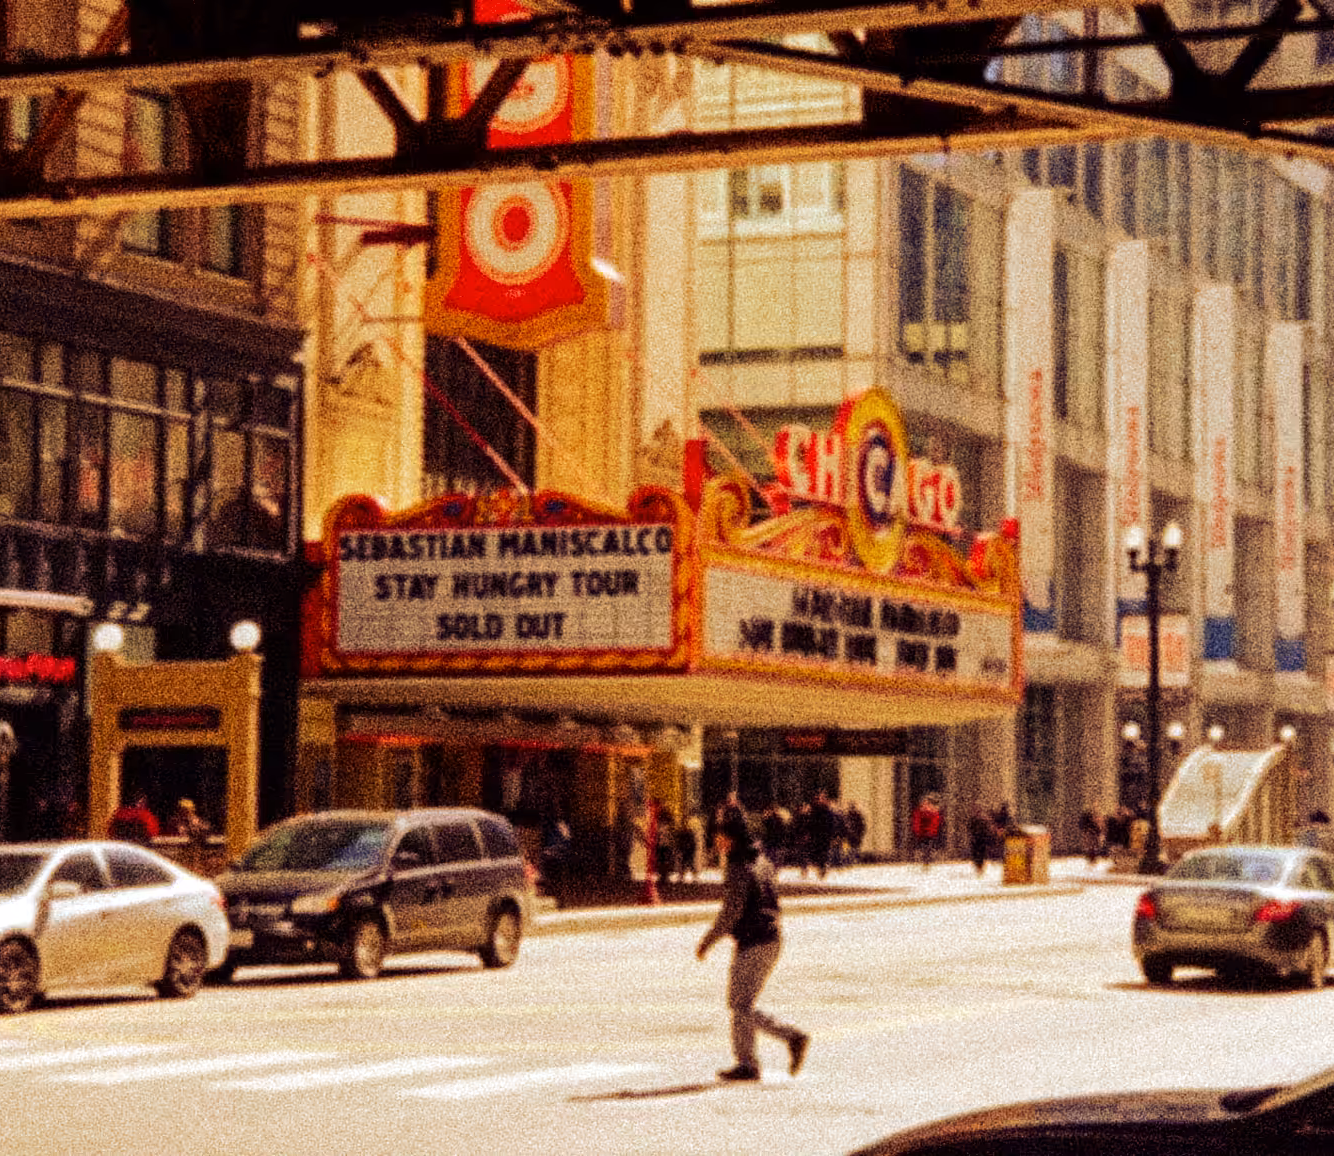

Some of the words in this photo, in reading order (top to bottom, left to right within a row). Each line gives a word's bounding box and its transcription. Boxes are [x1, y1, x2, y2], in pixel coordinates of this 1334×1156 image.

[340, 533, 486, 562] SEBASTIAN
[498, 527, 672, 558] MANISCALCO
[374, 573, 438, 600] STAY
[452, 571, 560, 598] HUNGRY
[571, 570, 639, 597] TOUR
[436, 613, 503, 640] SOLD
[515, 612, 566, 639] OUT
